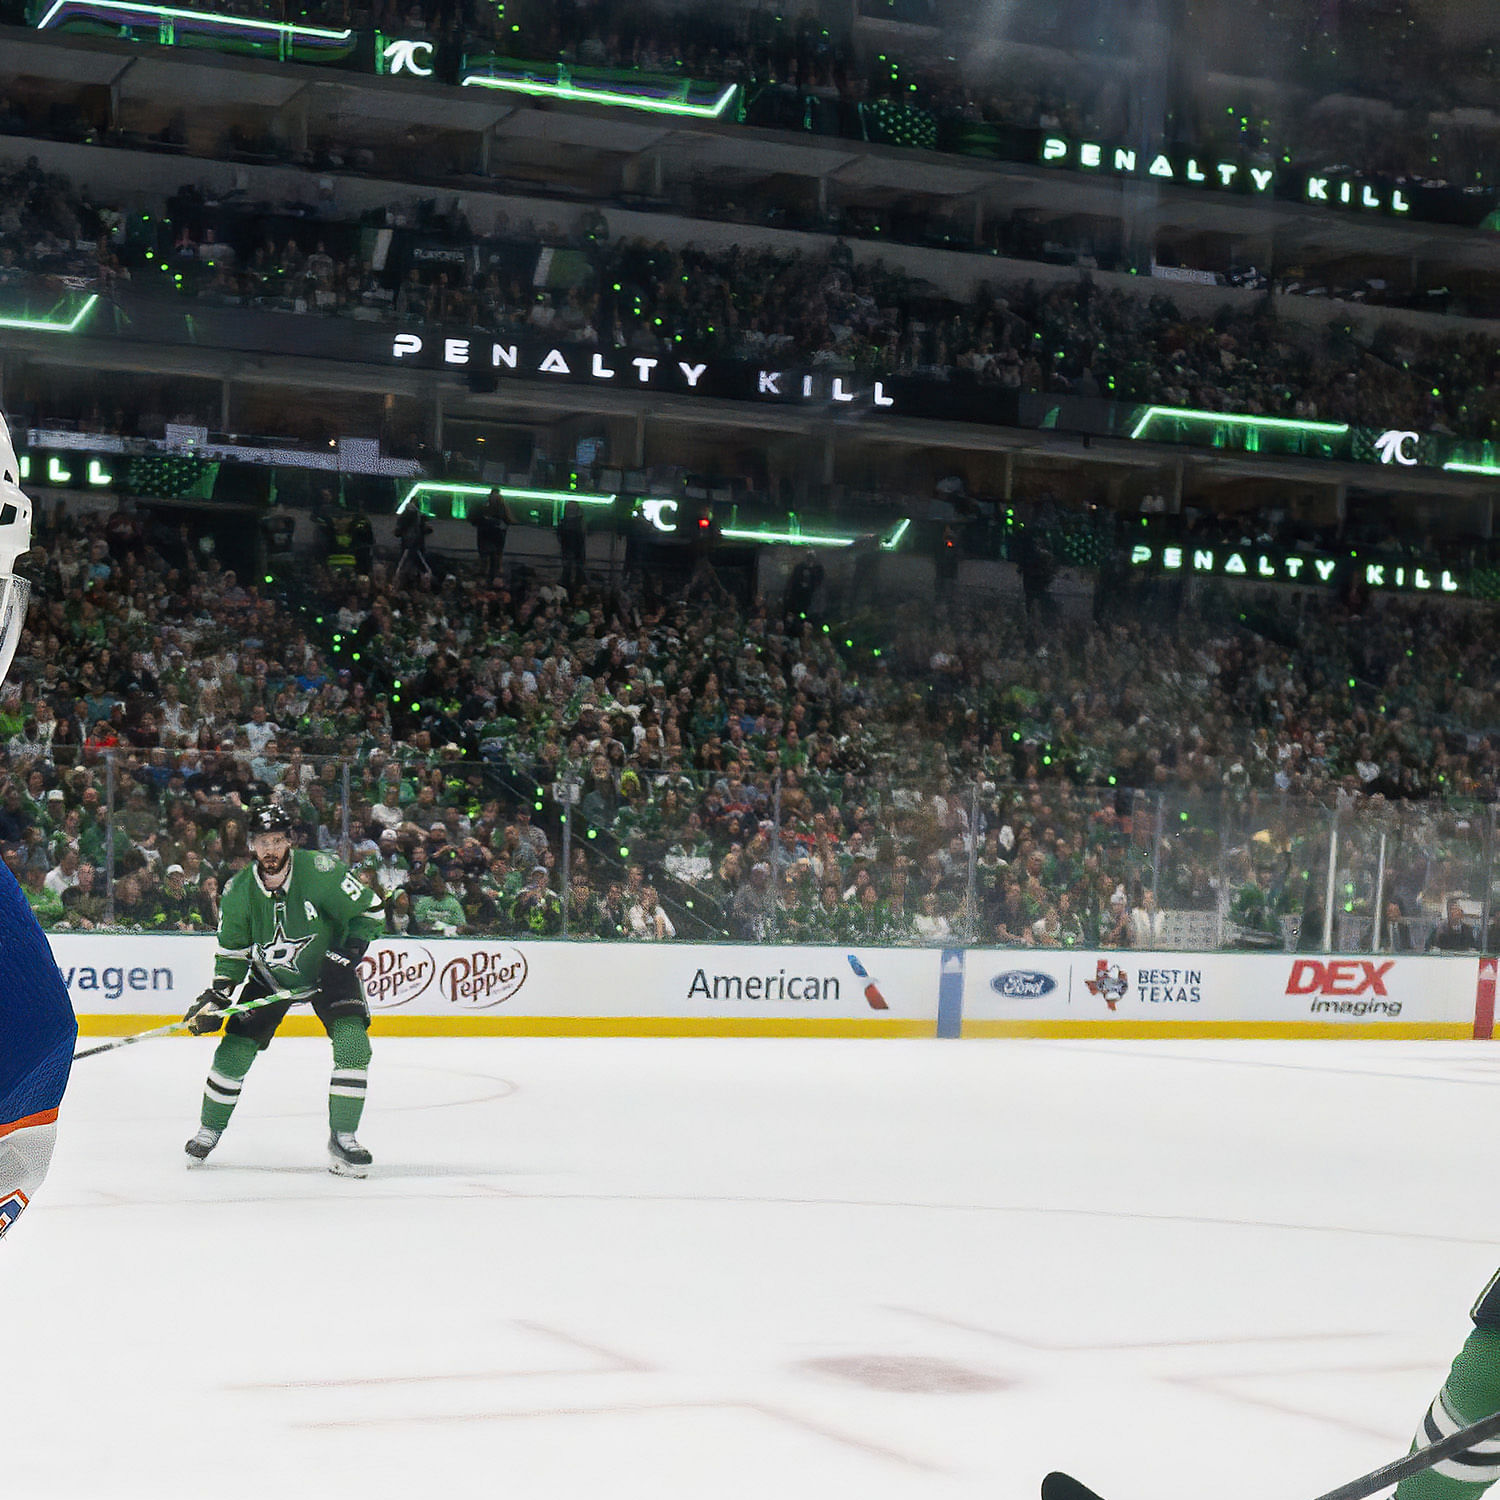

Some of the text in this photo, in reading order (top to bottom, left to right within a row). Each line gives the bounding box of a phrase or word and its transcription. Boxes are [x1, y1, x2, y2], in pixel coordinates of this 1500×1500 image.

[1042, 138, 1411, 213] PENALTY KILL
[392, 333, 896, 407] PENALTY KILL
[17, 455, 113, 486] ILL
[1131, 545, 1459, 592] PENALTY KILL
[377, 949, 409, 977] Dr
[471, 950, 502, 979] Dr
[1138, 968, 1202, 985] BEST IN
[1285, 959, 1396, 996] DEX
[444, 956, 522, 1003] Pepper
[687, 967, 841, 1001] American
[1003, 973, 1045, 997] Ford
[1137, 986, 1202, 1003] TEXAS
[1310, 996, 1403, 1017] imaging
